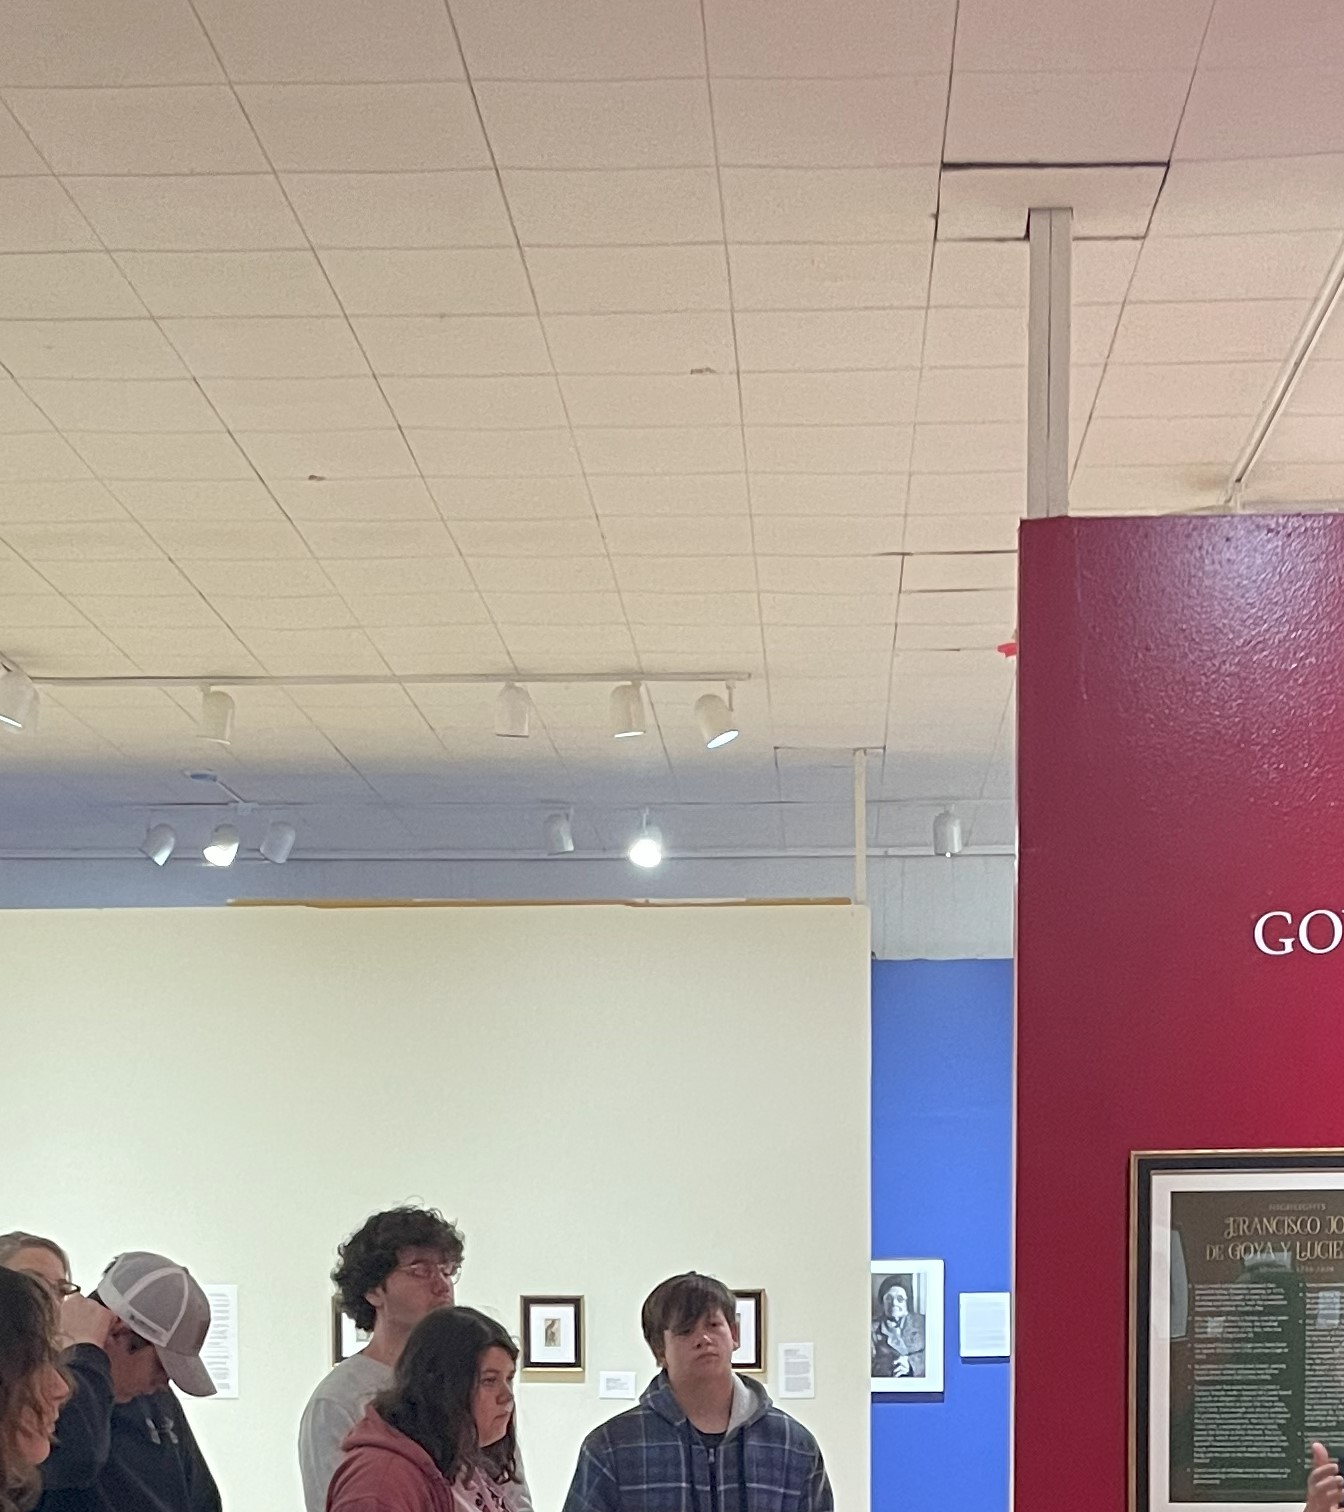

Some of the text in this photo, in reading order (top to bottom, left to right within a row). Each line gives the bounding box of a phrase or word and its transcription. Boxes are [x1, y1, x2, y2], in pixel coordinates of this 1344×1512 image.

[1223, 1215, 1321, 1239] FRANCISCO
[1205, 1244, 1225, 1261] DE
[1228, 1240, 1276, 1261] GOYA
[1280, 1240, 1292, 1260] Y
